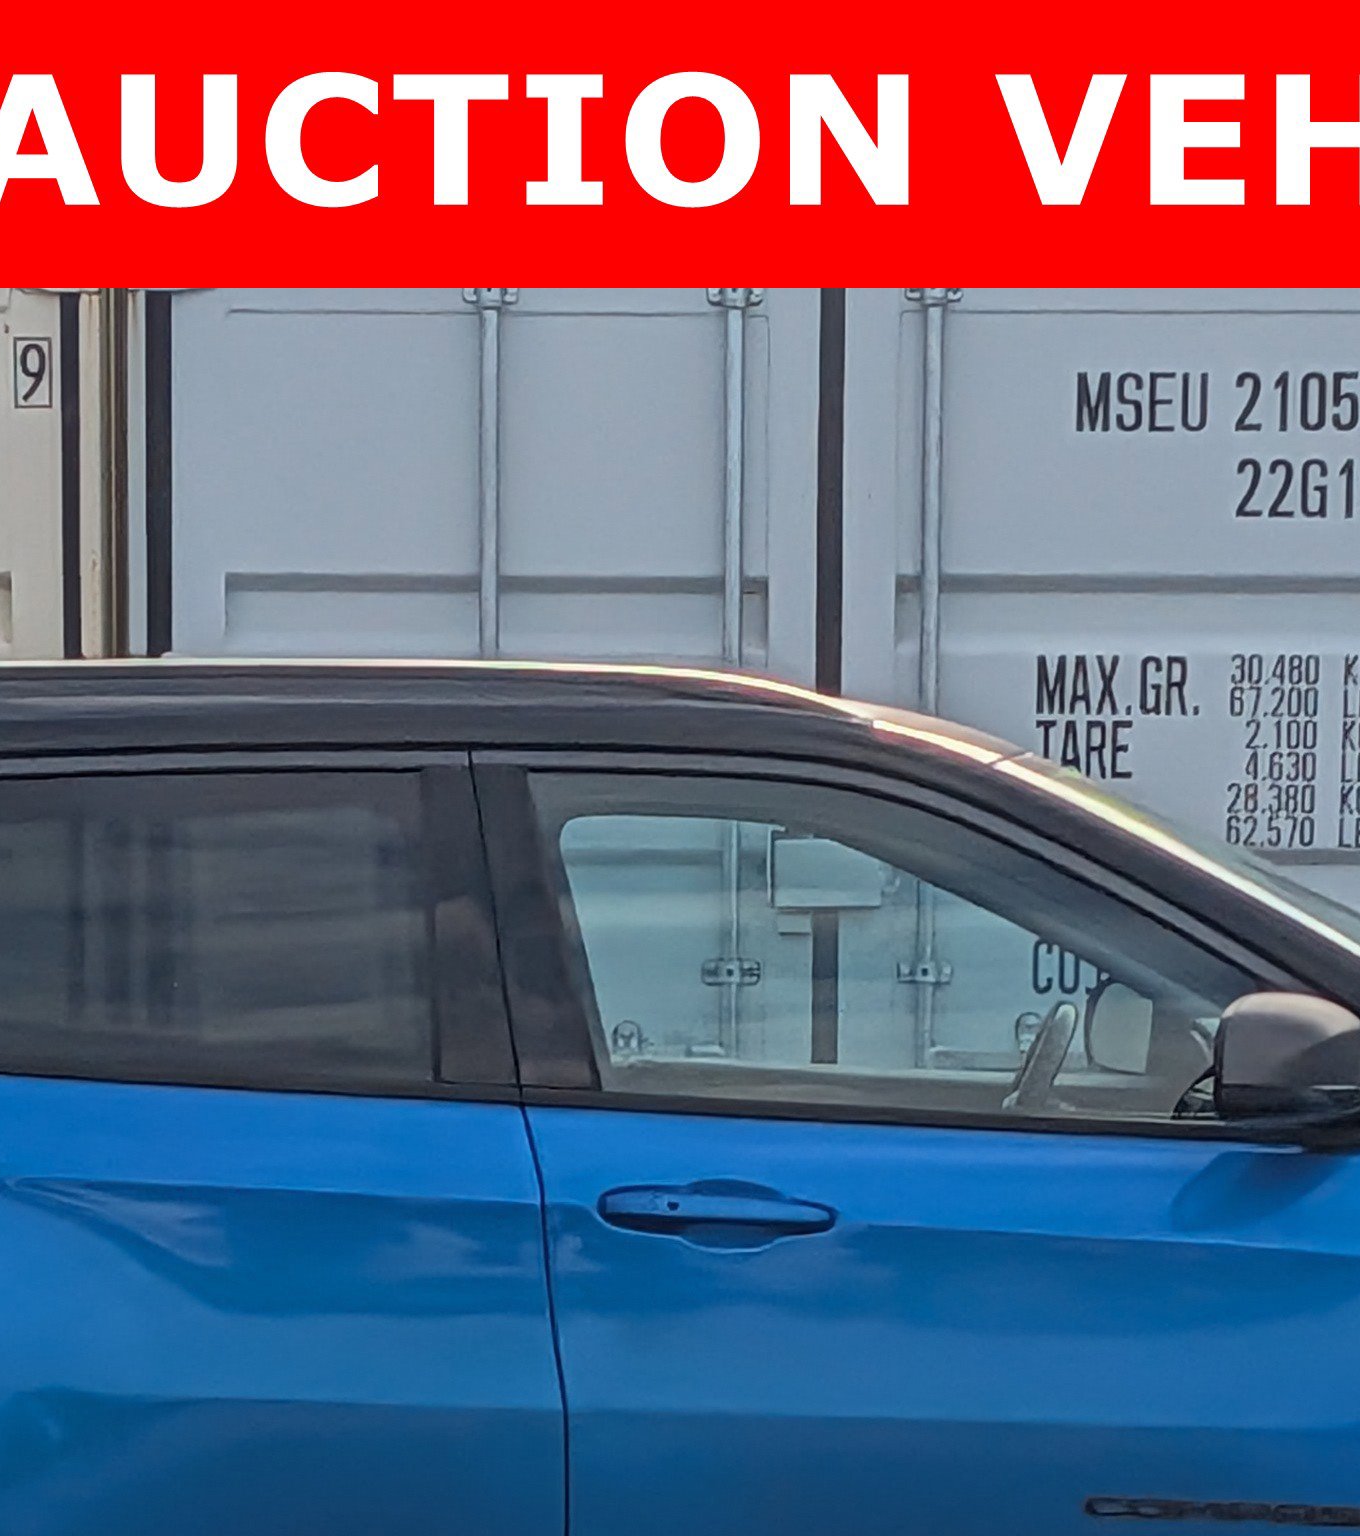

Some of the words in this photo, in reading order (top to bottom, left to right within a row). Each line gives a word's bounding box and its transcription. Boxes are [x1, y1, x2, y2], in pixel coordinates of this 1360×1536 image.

[20, 343, 46, 402] 9
[1076, 372, 1209, 433] MSEU
[1236, 458, 1355, 520] 22G1
[1231, 654, 1320, 685] 30.480
[1229, 686, 1319, 718] 67.200
[1035, 720, 1134, 779] TARE
[1245, 719, 1318, 750] 2.100
[1245, 751, 1317, 783] 4.630
[1226, 783, 1316, 814] 28.380
[1225, 815, 1315, 847] 62.570
